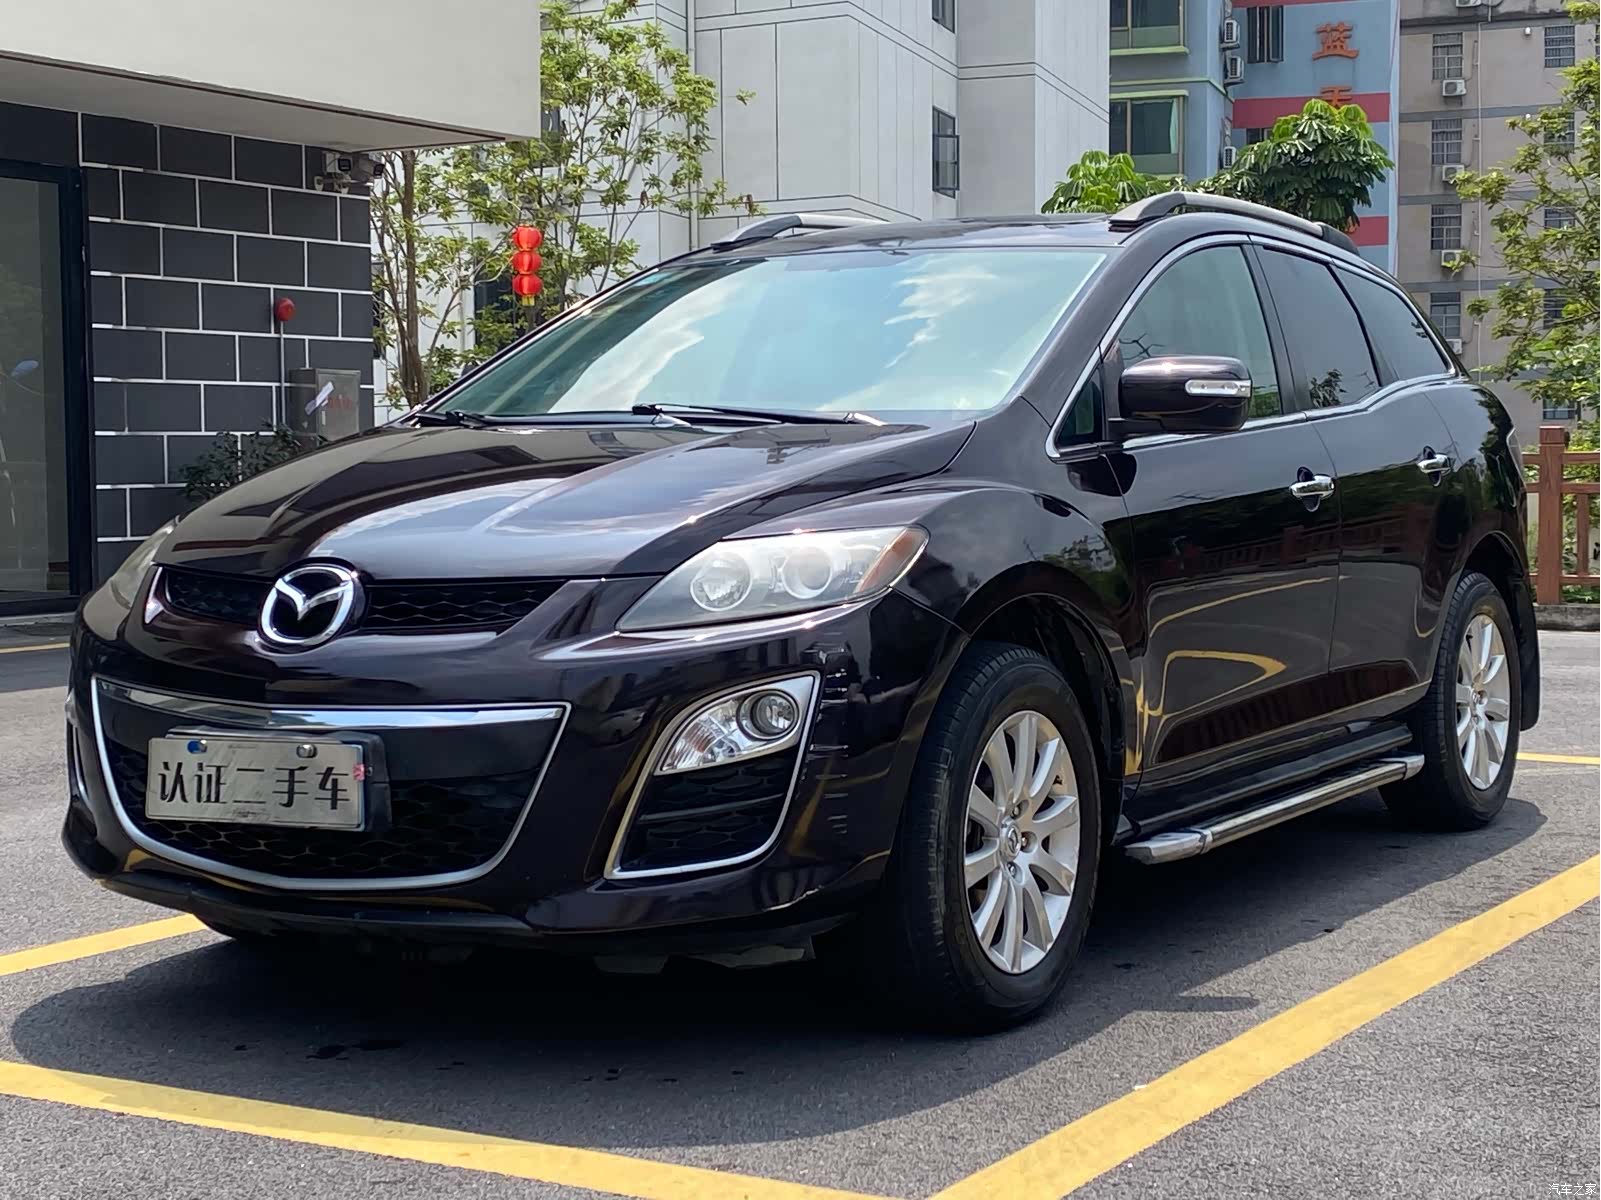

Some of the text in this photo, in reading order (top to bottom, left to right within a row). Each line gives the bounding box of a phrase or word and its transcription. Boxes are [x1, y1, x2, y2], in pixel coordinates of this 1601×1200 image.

[158, 761, 350, 810] 认证二手车
